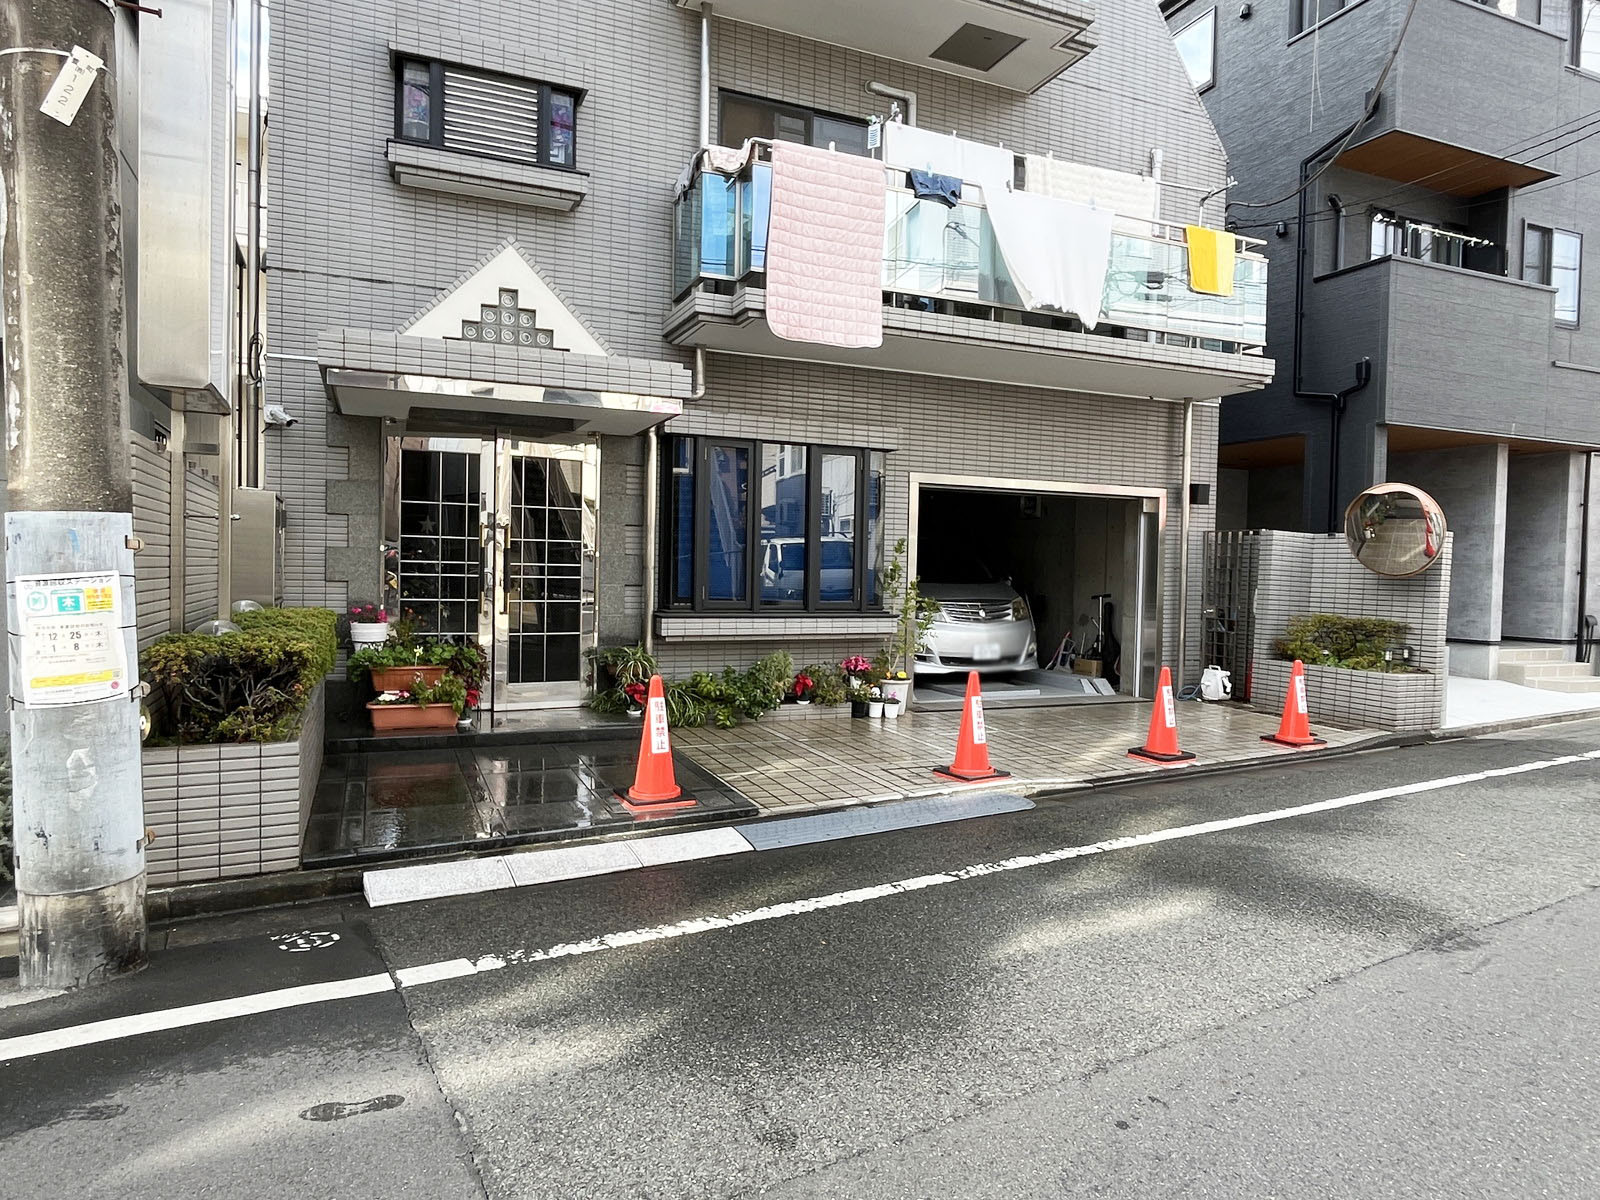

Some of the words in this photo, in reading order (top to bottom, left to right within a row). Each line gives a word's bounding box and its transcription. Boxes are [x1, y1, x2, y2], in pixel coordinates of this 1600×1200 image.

[63, 596, 76, 607] 木
[48, 632, 58, 641] 12
[69, 631, 82, 640] 25
[74, 642, 80, 651] 8
[655, 701, 666, 750] 駐車禁止
